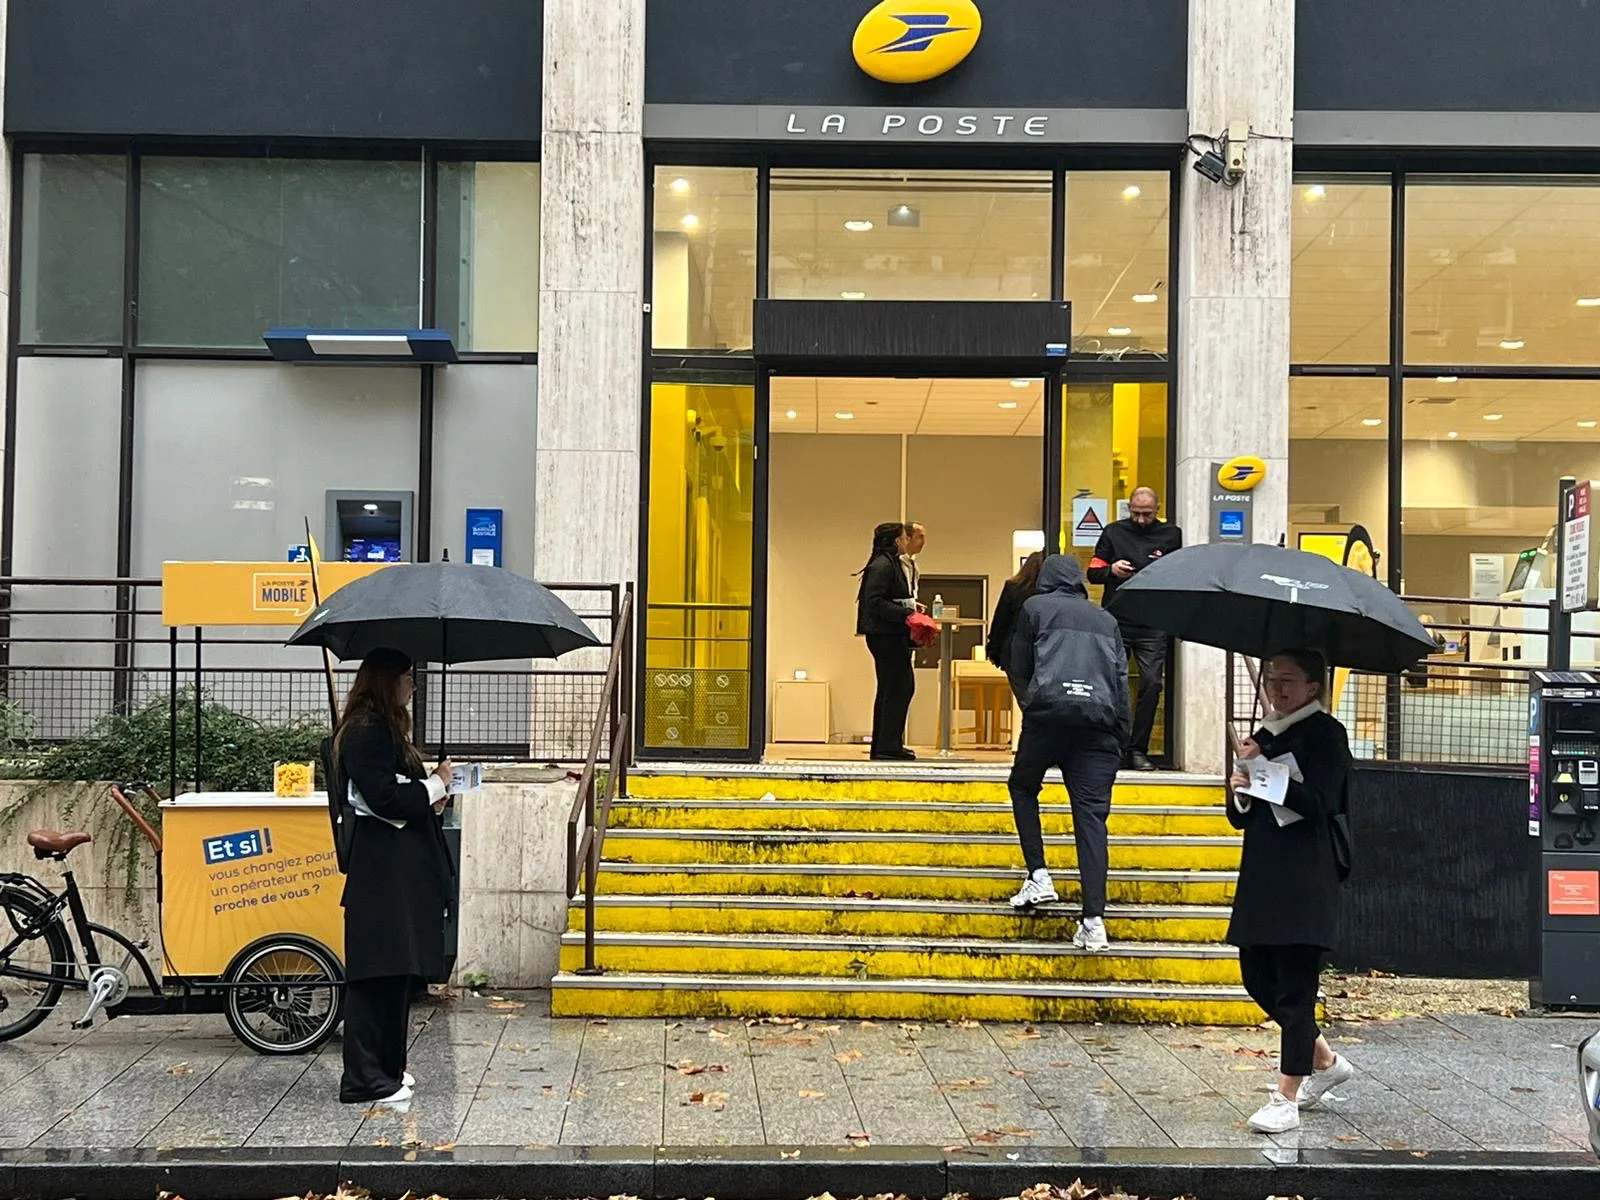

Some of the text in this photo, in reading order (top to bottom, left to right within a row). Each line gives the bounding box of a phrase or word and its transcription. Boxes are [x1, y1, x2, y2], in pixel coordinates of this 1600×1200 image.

[786, 113, 1049, 136] LA POSTE
[1225, 494, 1250, 502] POSTE
[1568, 494, 1575, 518] P
[261, 587, 307, 603] MOBILE
[1530, 697, 1537, 728] P
[208, 840, 235, 861] Et
[239, 834, 258, 855] si
[208, 850, 338, 881] vous changiez pour
[211, 864, 339, 897] un opérateur mobil
[214, 897, 258, 914] proche
[261, 893, 278, 904] de
[280, 887, 310, 900] vous
